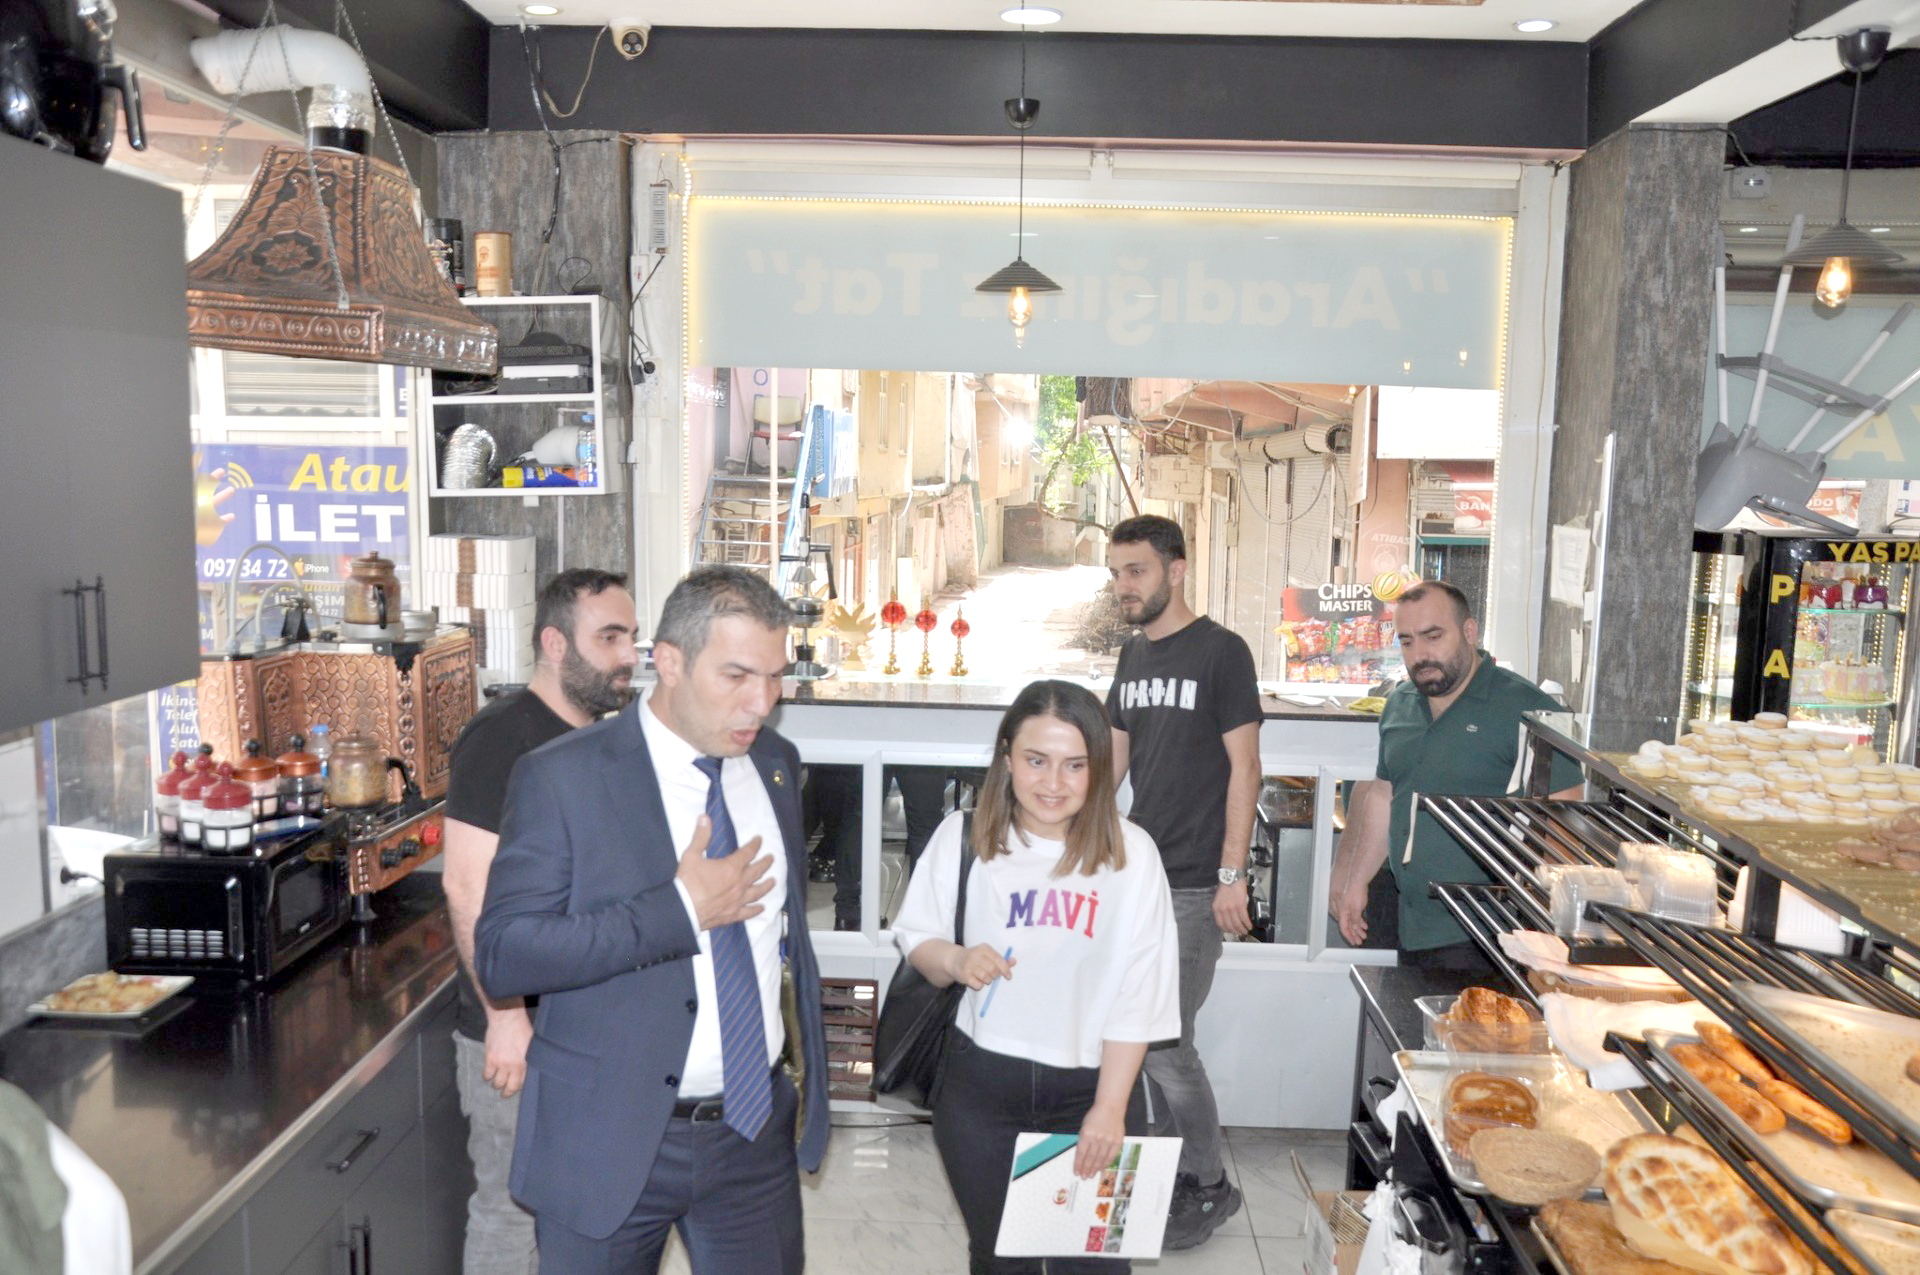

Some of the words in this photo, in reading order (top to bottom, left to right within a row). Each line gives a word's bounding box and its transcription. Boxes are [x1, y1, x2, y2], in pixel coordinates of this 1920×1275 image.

[255, 494, 405, 542] İLET
[203, 558, 236, 577] 097
[241, 558, 261, 577] 34
[267, 558, 288, 577] 72
[304, 564, 330, 573] iPhone
[1318, 583, 1372, 600] CHIPS
[1319, 600, 1373, 612] MASTER
[1120, 678, 1198, 711] JORDAN
